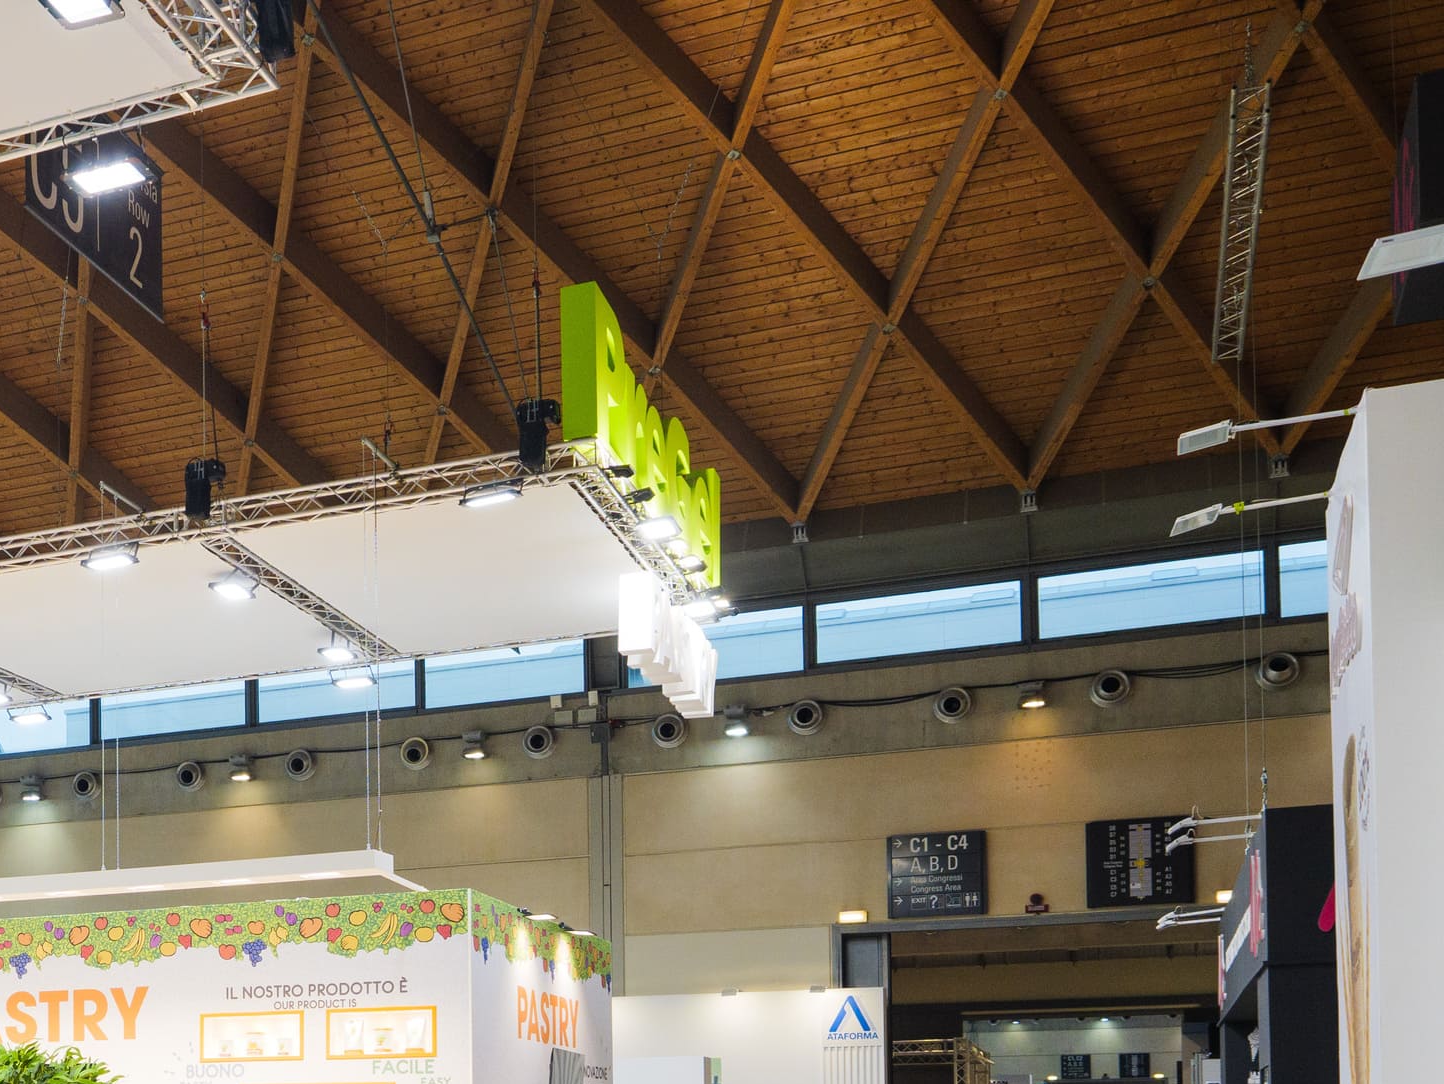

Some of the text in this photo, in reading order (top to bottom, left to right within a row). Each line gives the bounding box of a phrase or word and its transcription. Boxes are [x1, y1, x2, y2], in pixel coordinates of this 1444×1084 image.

[128, 189, 150, 229] Row
[129, 226, 144, 289] 2
[909, 837, 929, 853] C1
[947, 834, 969, 851] C4
[910, 855, 958, 873] A, B, D
[911, 896, 926, 904] EXIT
[226, 977, 408, 1000] IL NOSTRO PRODOTTO È
[273, 998, 357, 1010] OUR PRODUCT IS
[517, 985, 580, 1048] PASTRY
[827, 1032, 879, 1040] ATAFORMA
[186, 1063, 245, 1079] BUONO
[372, 1059, 435, 1075] FACILE
